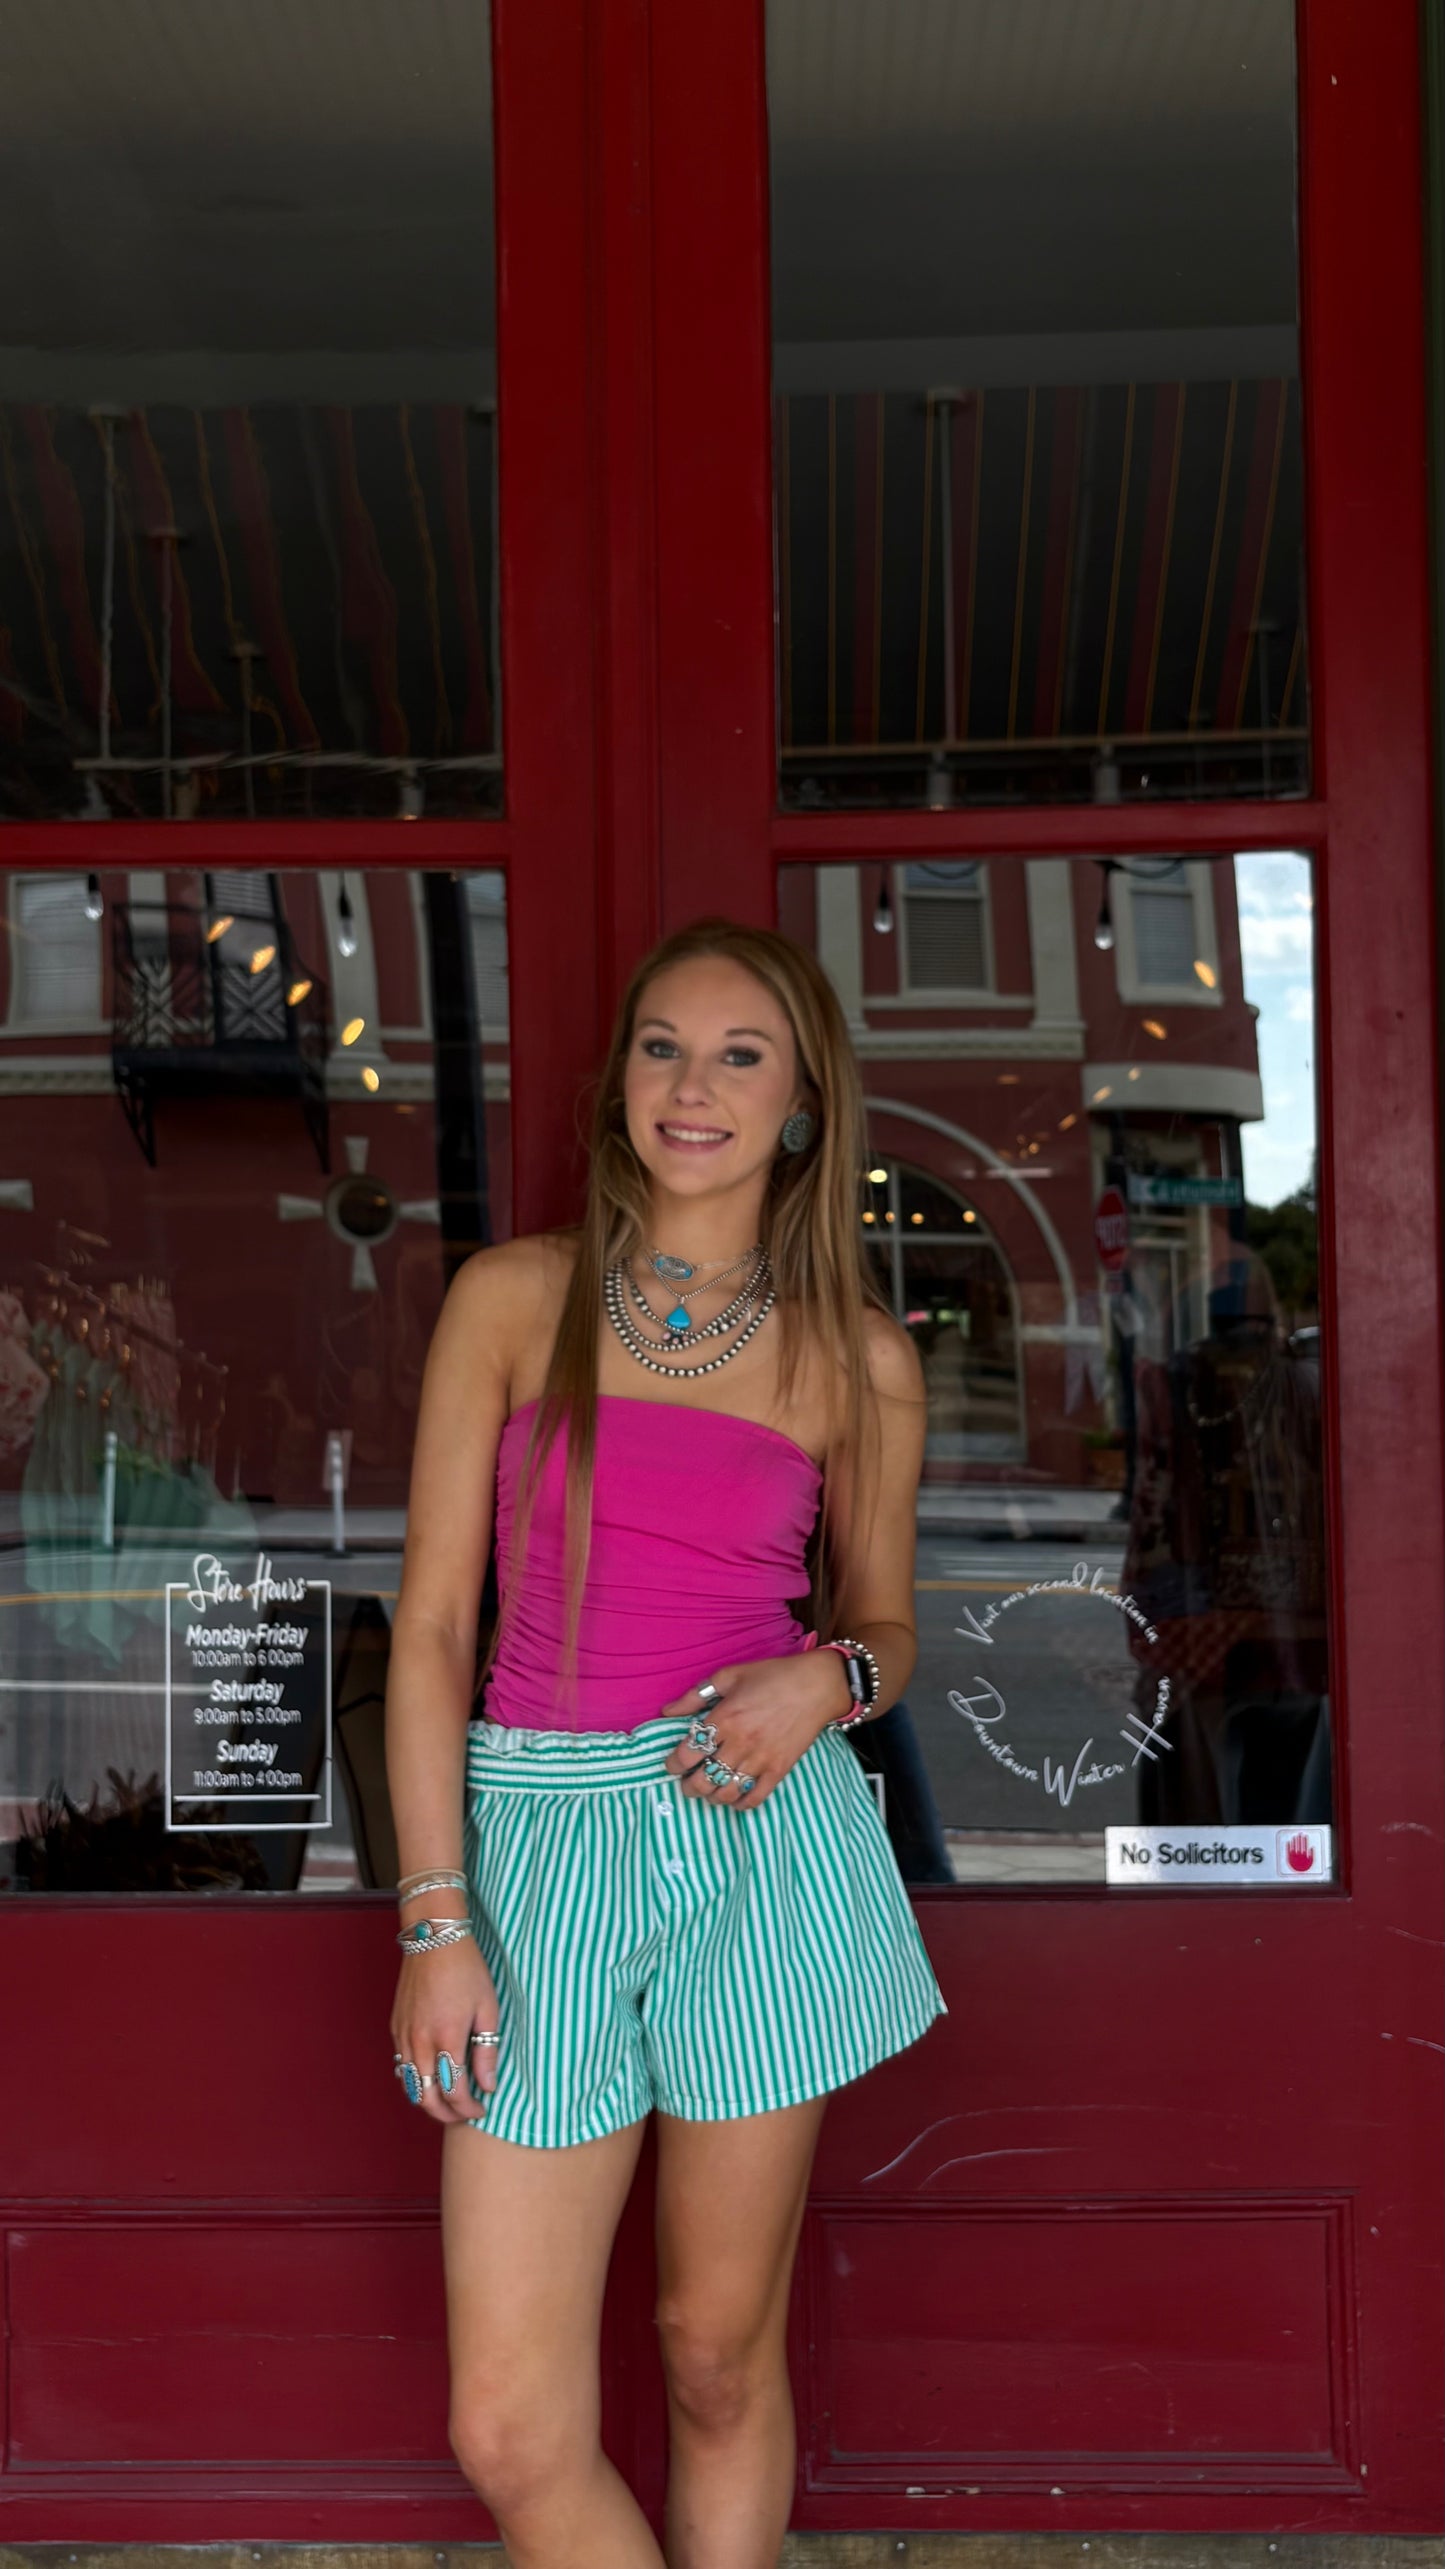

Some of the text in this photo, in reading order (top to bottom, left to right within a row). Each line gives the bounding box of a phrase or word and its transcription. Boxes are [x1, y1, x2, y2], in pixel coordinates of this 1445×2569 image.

[187, 1552, 307, 1612] Store Hours
[1001, 1591, 1025, 1610] our
[1025, 1561, 1088, 1596] second
[1089, 1566, 1148, 1629] location
[1144, 1624, 1159, 1645] in
[186, 1622, 309, 1649] Monday-Friday
[243, 1650, 257, 1666] to
[209, 1678, 284, 1705] Saturday
[240, 1708, 255, 1724] to
[215, 1738, 279, 1765] Sunday
[946, 1675, 1175, 1807] Downtown Winter Haven
[240, 1770, 255, 1787] to
[1120, 1841, 1264, 1865] No Solicitors
